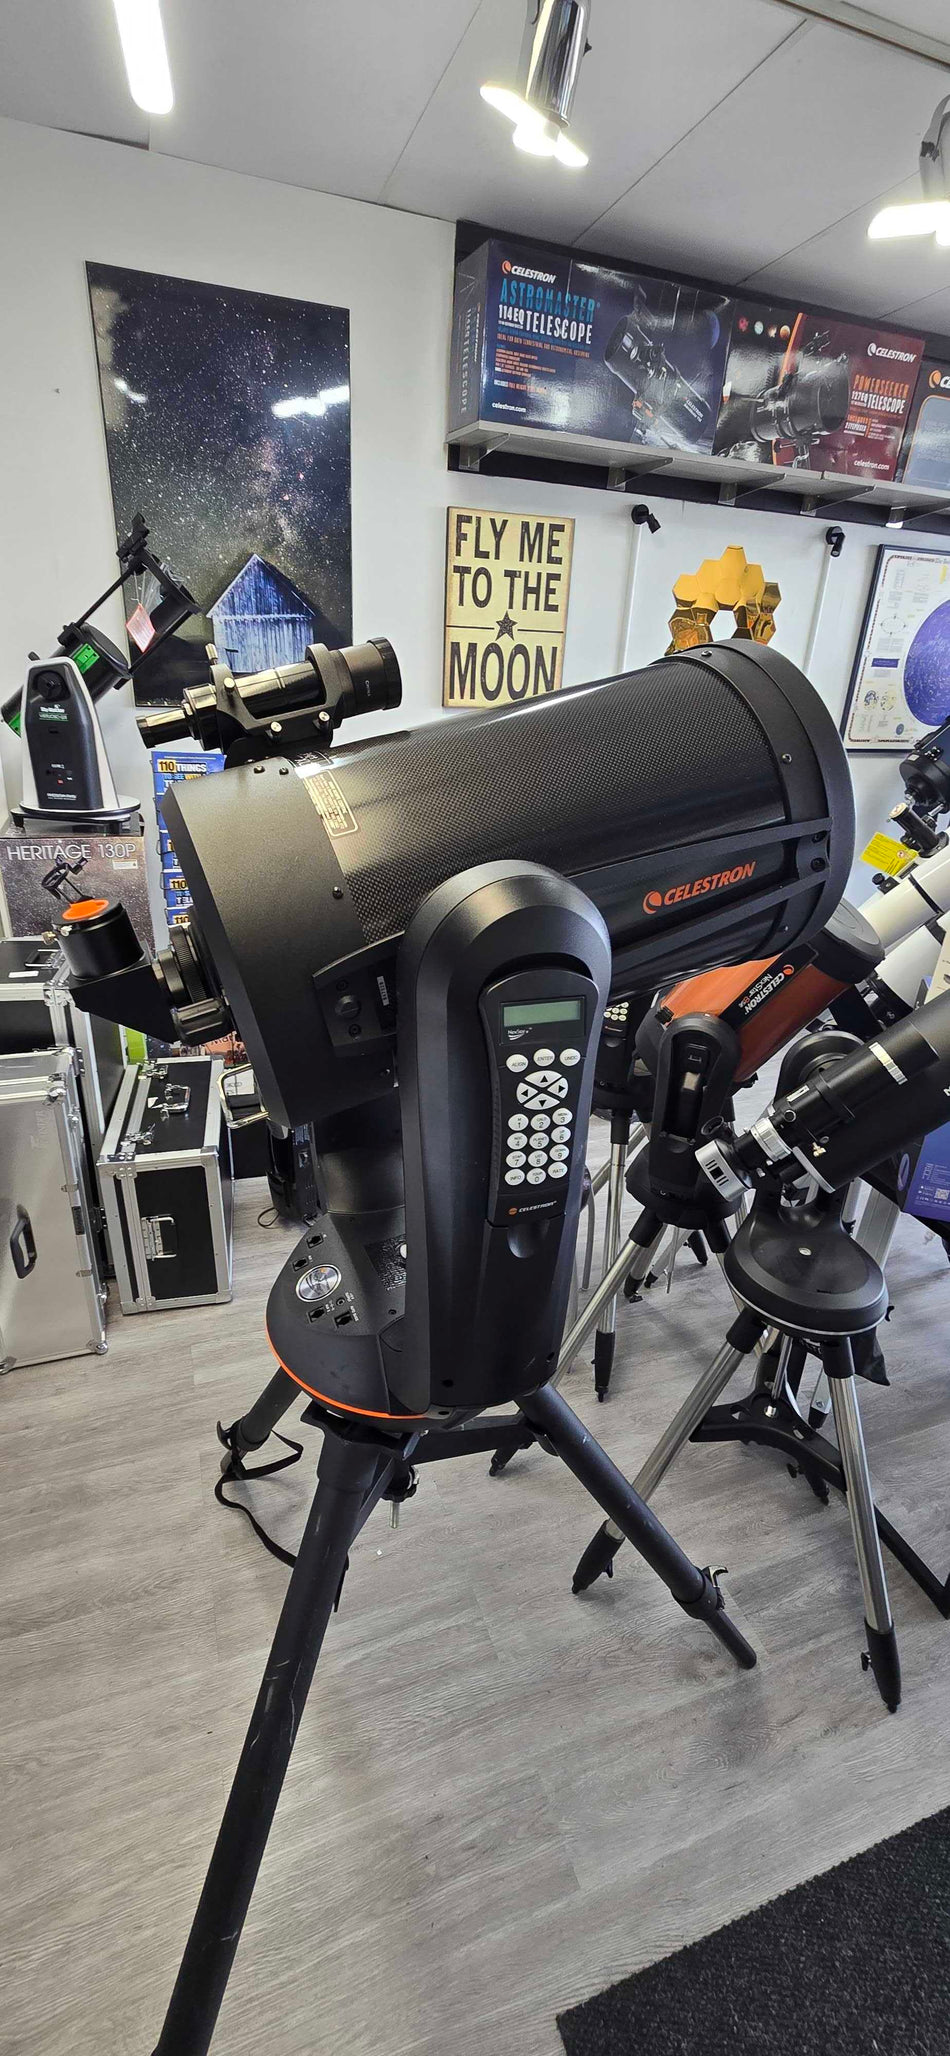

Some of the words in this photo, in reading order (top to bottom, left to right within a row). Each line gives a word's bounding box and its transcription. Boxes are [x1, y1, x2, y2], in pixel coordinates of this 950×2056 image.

[511, 265, 556, 284] CELESTRON
[500, 278, 596, 323] ASTROMASTER
[498, 304, 525, 326] 114EQ
[524, 310, 593, 345] TELESCOPE
[876, 347, 917, 363] CELESTRON
[460, 338, 471, 414] TELESCOPE
[853, 374, 910, 399] POWERSEEKER
[491, 402, 527, 414] celestron.com
[867, 392, 906, 414] TELESCOPE
[853, 459, 890, 471] celestron.com
[455, 514, 509, 560] FLY
[519, 521, 565, 565] ME
[453, 565, 492, 609] TO
[504, 569, 561, 613] THE
[450, 641, 558, 701] MOON
[159, 761, 175, 771] 110
[176, 763, 208, 772] THINGS
[7, 843, 92, 861] HERITAGE
[98, 843, 136, 858] 130P
[171, 880, 187, 889] 110
[663, 860, 757, 905] CELESTRON
[745, 972, 785, 1013] CELESTRON
[749, 973, 773, 998] NexStar
[518, 1202, 554, 1213] CELESTRON
